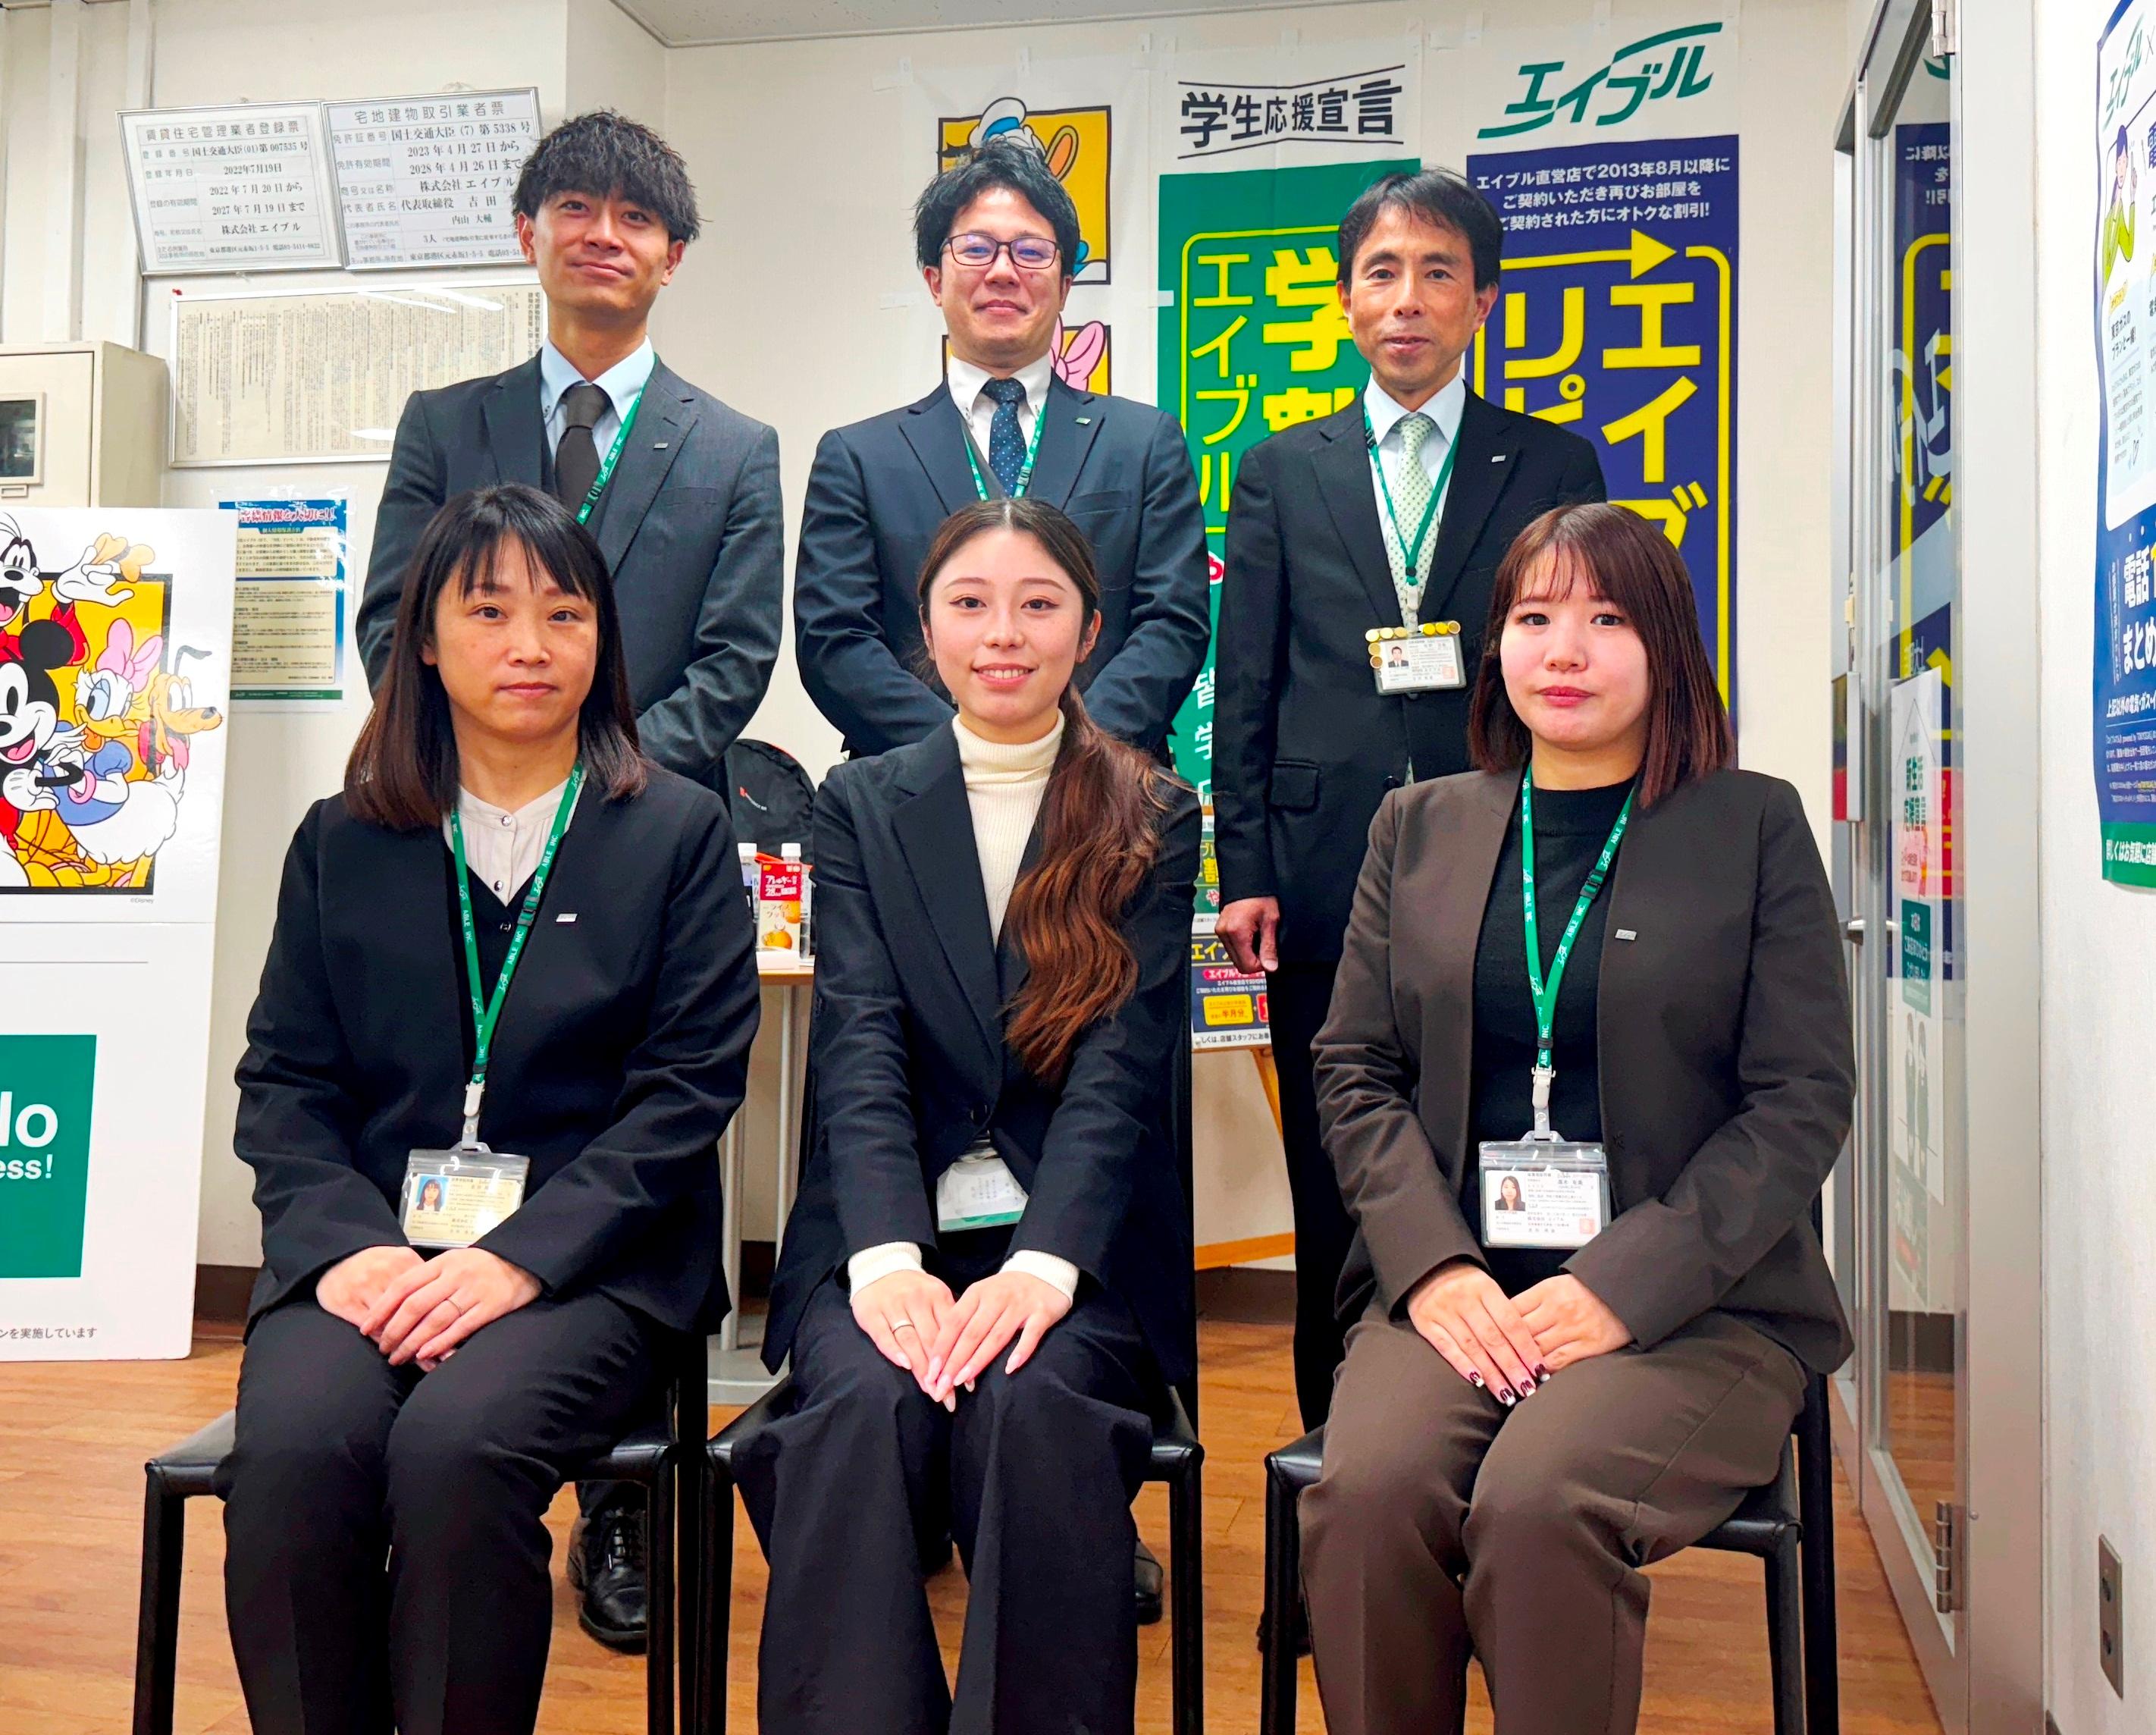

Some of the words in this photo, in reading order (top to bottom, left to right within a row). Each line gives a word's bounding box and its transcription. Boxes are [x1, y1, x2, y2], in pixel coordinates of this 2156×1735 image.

[1477, 21, 1723, 140] エイブル
[354, 100, 505, 125] 宅地建物取引業者票
[1180, 79, 1403, 149] 学生応援宣言
[146, 120, 300, 142] 賃貸住宅管理業者登録票
[223, 162, 283, 175] 2022年7月19日
[1476, 157, 1730, 189] エイブル直営店で2013年8月以降に
[401, 198, 455, 212] 代表取締役
[1503, 181, 1702, 210] ご契約いただき再びお部屋を
[1501, 202, 1710, 231] ご契約された方にオトクな割引!
[1610, 827, 1623, 845] ABLE
[541, 850, 553, 868] ABLE
[462, 909, 471, 927] ABLE
[1566, 919, 1579, 938] ABLE
[507, 946, 519, 965] ABLE
[1222, 1008, 1245, 1018] 半月分
[1540, 1049, 1549, 1065] ABL
